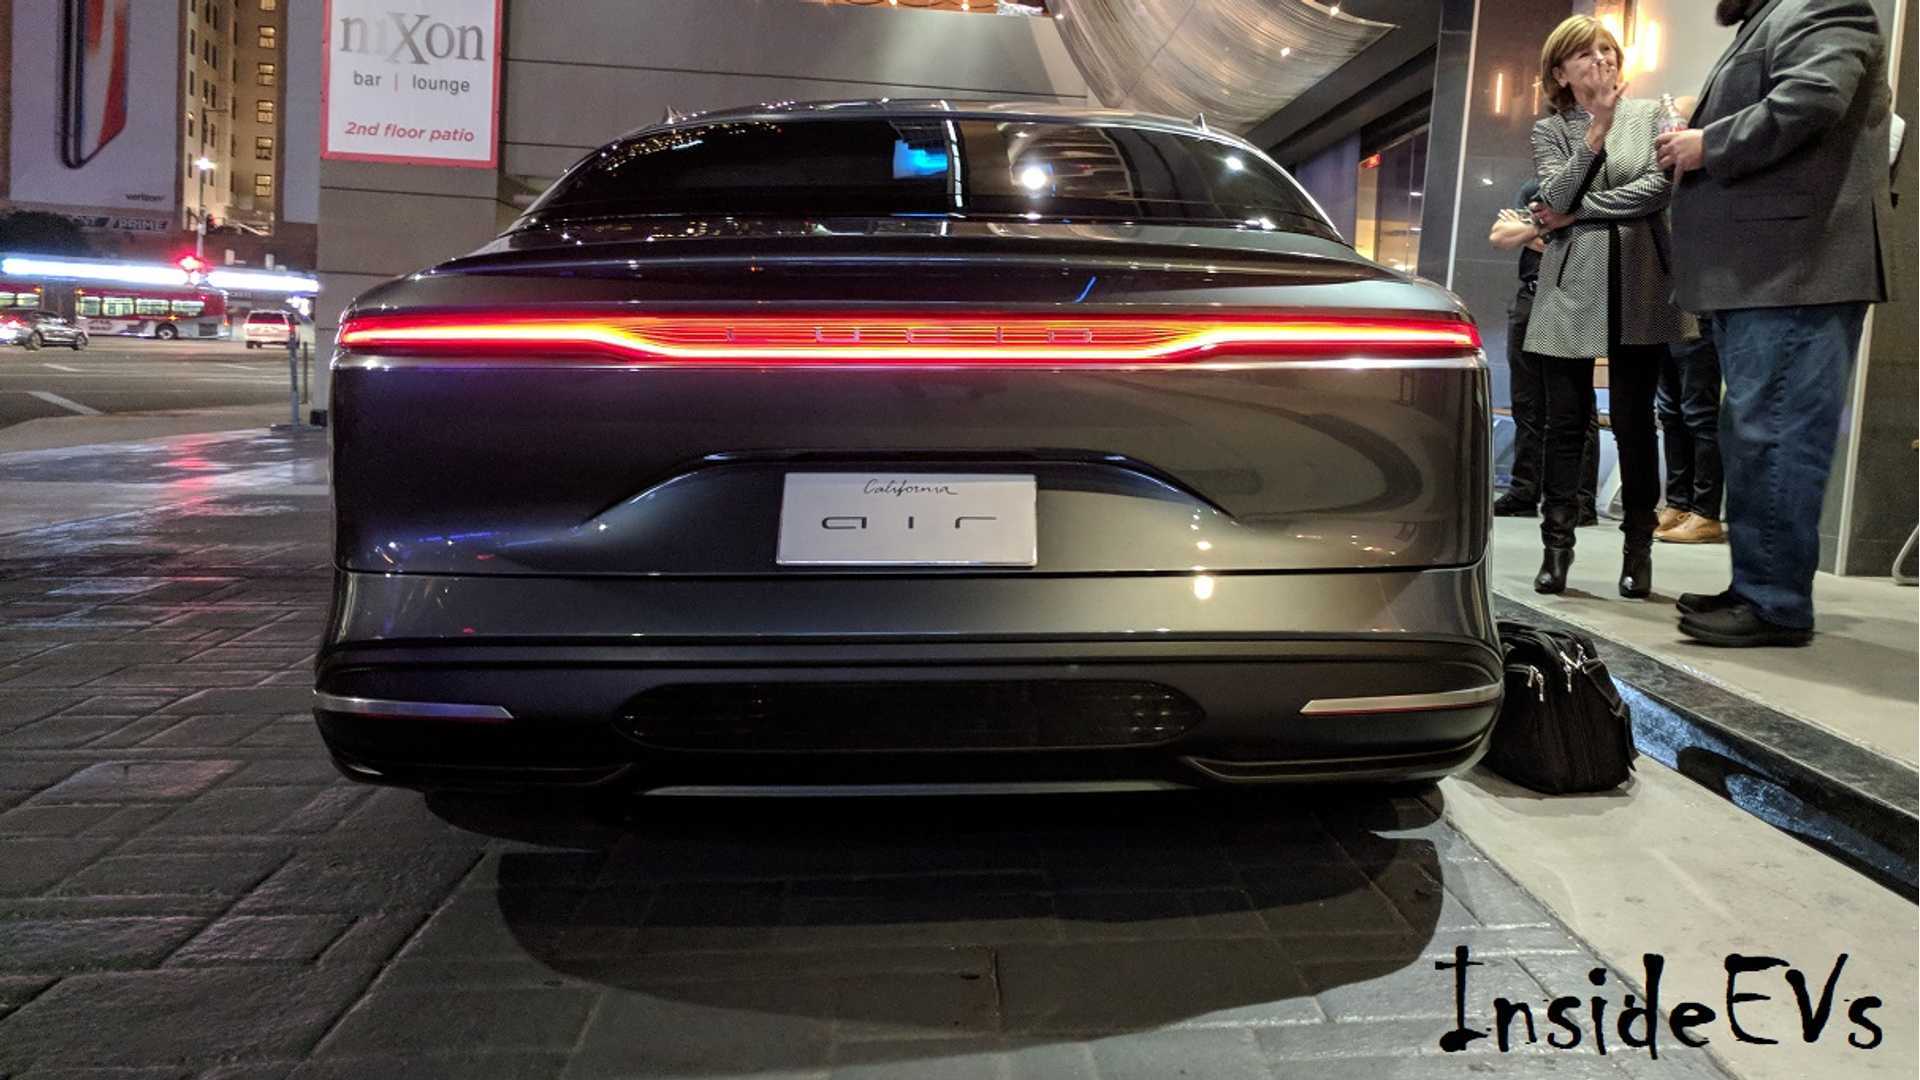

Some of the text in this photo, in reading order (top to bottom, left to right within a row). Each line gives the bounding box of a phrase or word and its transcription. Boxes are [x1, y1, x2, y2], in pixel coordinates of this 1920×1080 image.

[353, 70, 471, 95] bar lounge
[344, 121, 475, 142] 2nd floor patio
[863, 479, 958, 497] California
[821, 516, 997, 530] air
